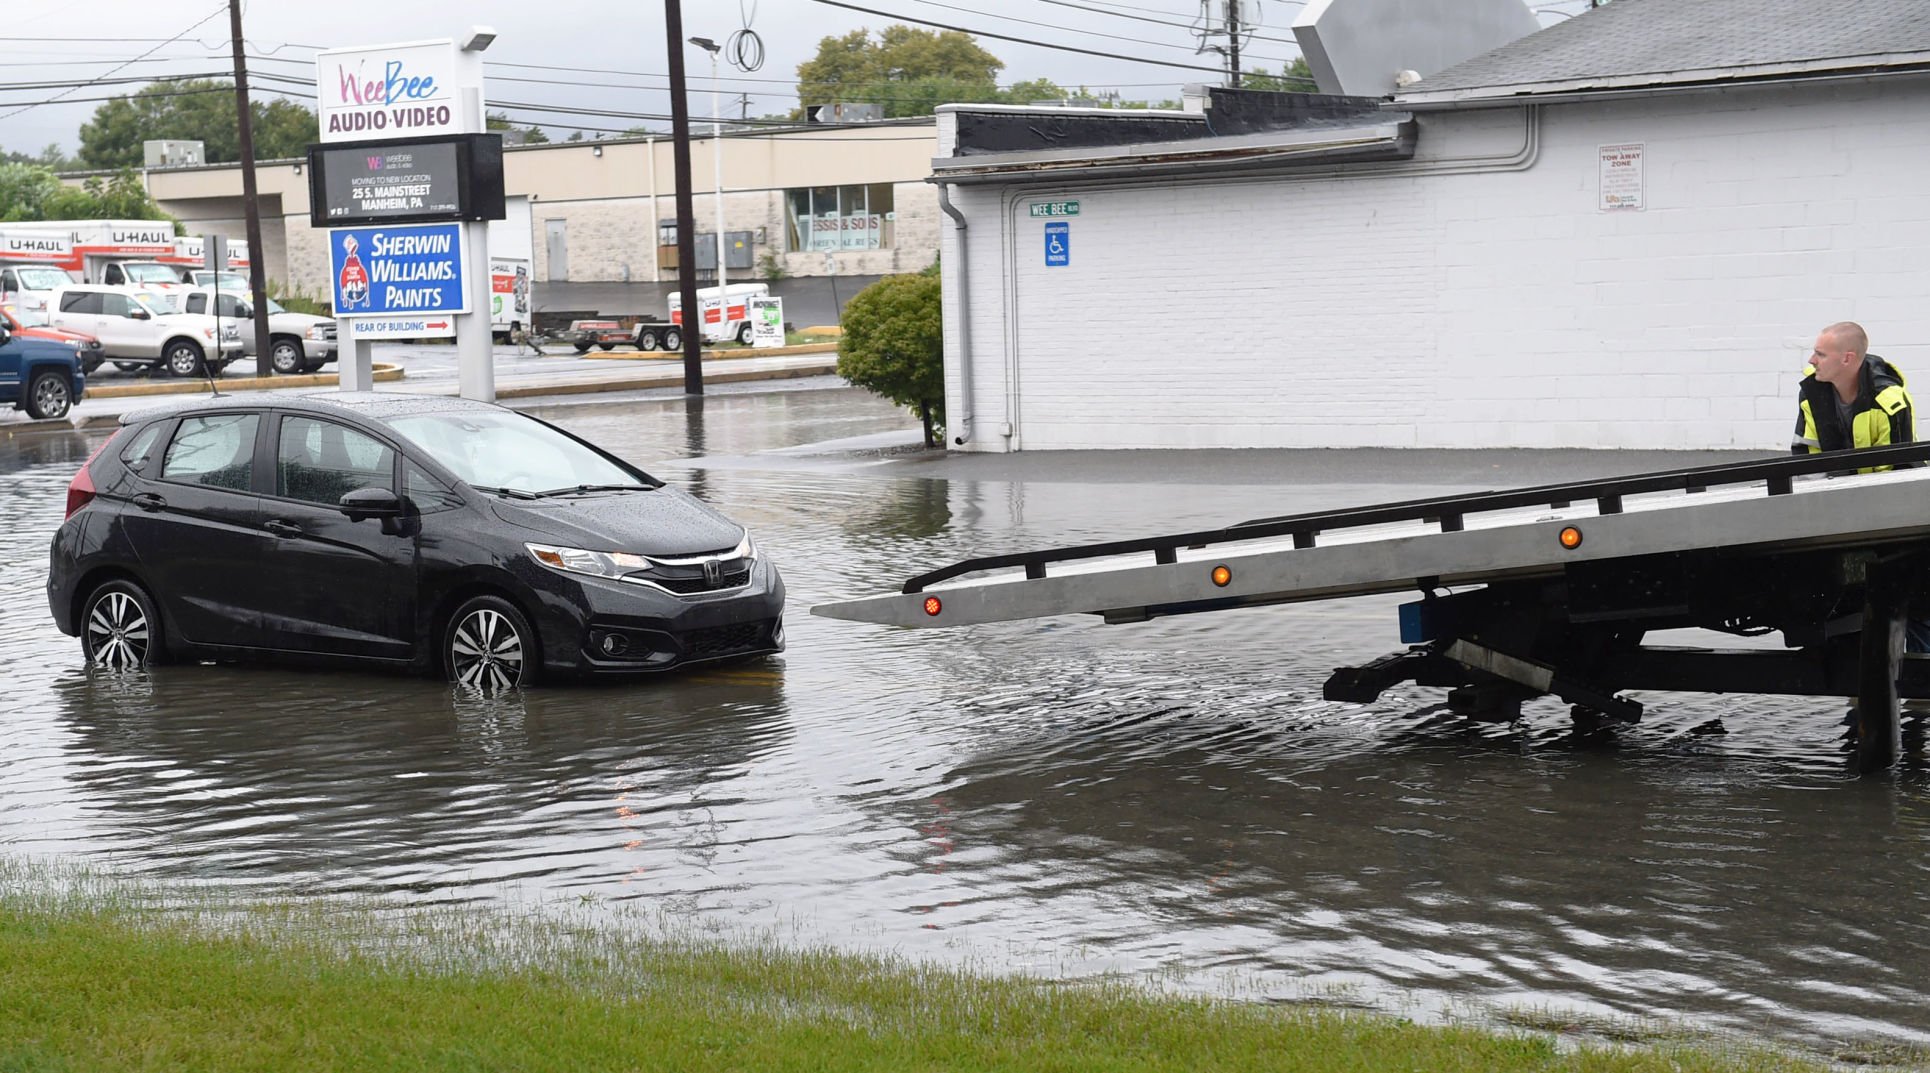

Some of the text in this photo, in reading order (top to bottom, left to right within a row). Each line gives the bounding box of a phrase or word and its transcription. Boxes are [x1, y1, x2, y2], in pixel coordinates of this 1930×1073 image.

[352, 174, 431, 186] MOVING TO NEW LOCATION
[352, 188, 364, 199] 25
[364, 187, 373, 198] S.
[362, 199, 409, 211] MANHEIM,
[411, 197, 423, 208] PA
[1031, 204, 1048, 215] WEE
[1051, 203, 1067, 215] BEE
[112, 232, 170, 243] U-HAUL
[10, 240, 64, 251] U-HAUL
[371, 233, 451, 257] SHERWIN
[385, 285, 442, 309] PAINTS
[355, 321, 425, 332] REAR OF BUILDING
